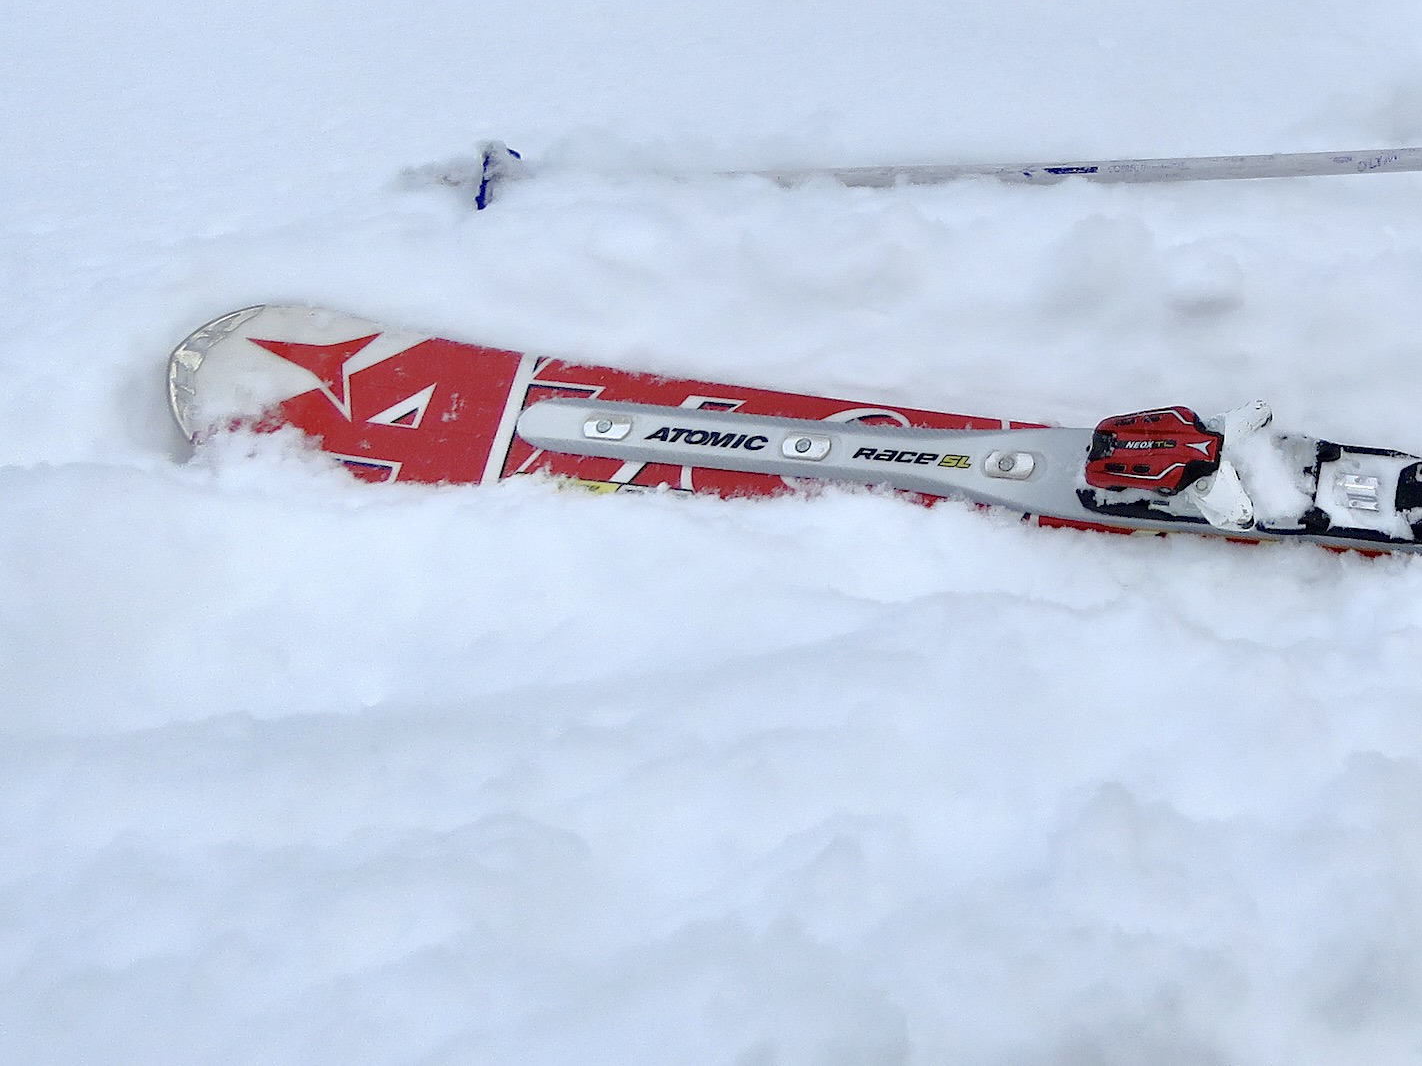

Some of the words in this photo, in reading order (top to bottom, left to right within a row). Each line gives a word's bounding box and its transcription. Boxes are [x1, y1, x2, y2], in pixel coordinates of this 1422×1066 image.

[646, 426, 768, 451] ATOMIC
[1125, 440, 1154, 449] NEOX
[936, 453, 973, 470] SL
